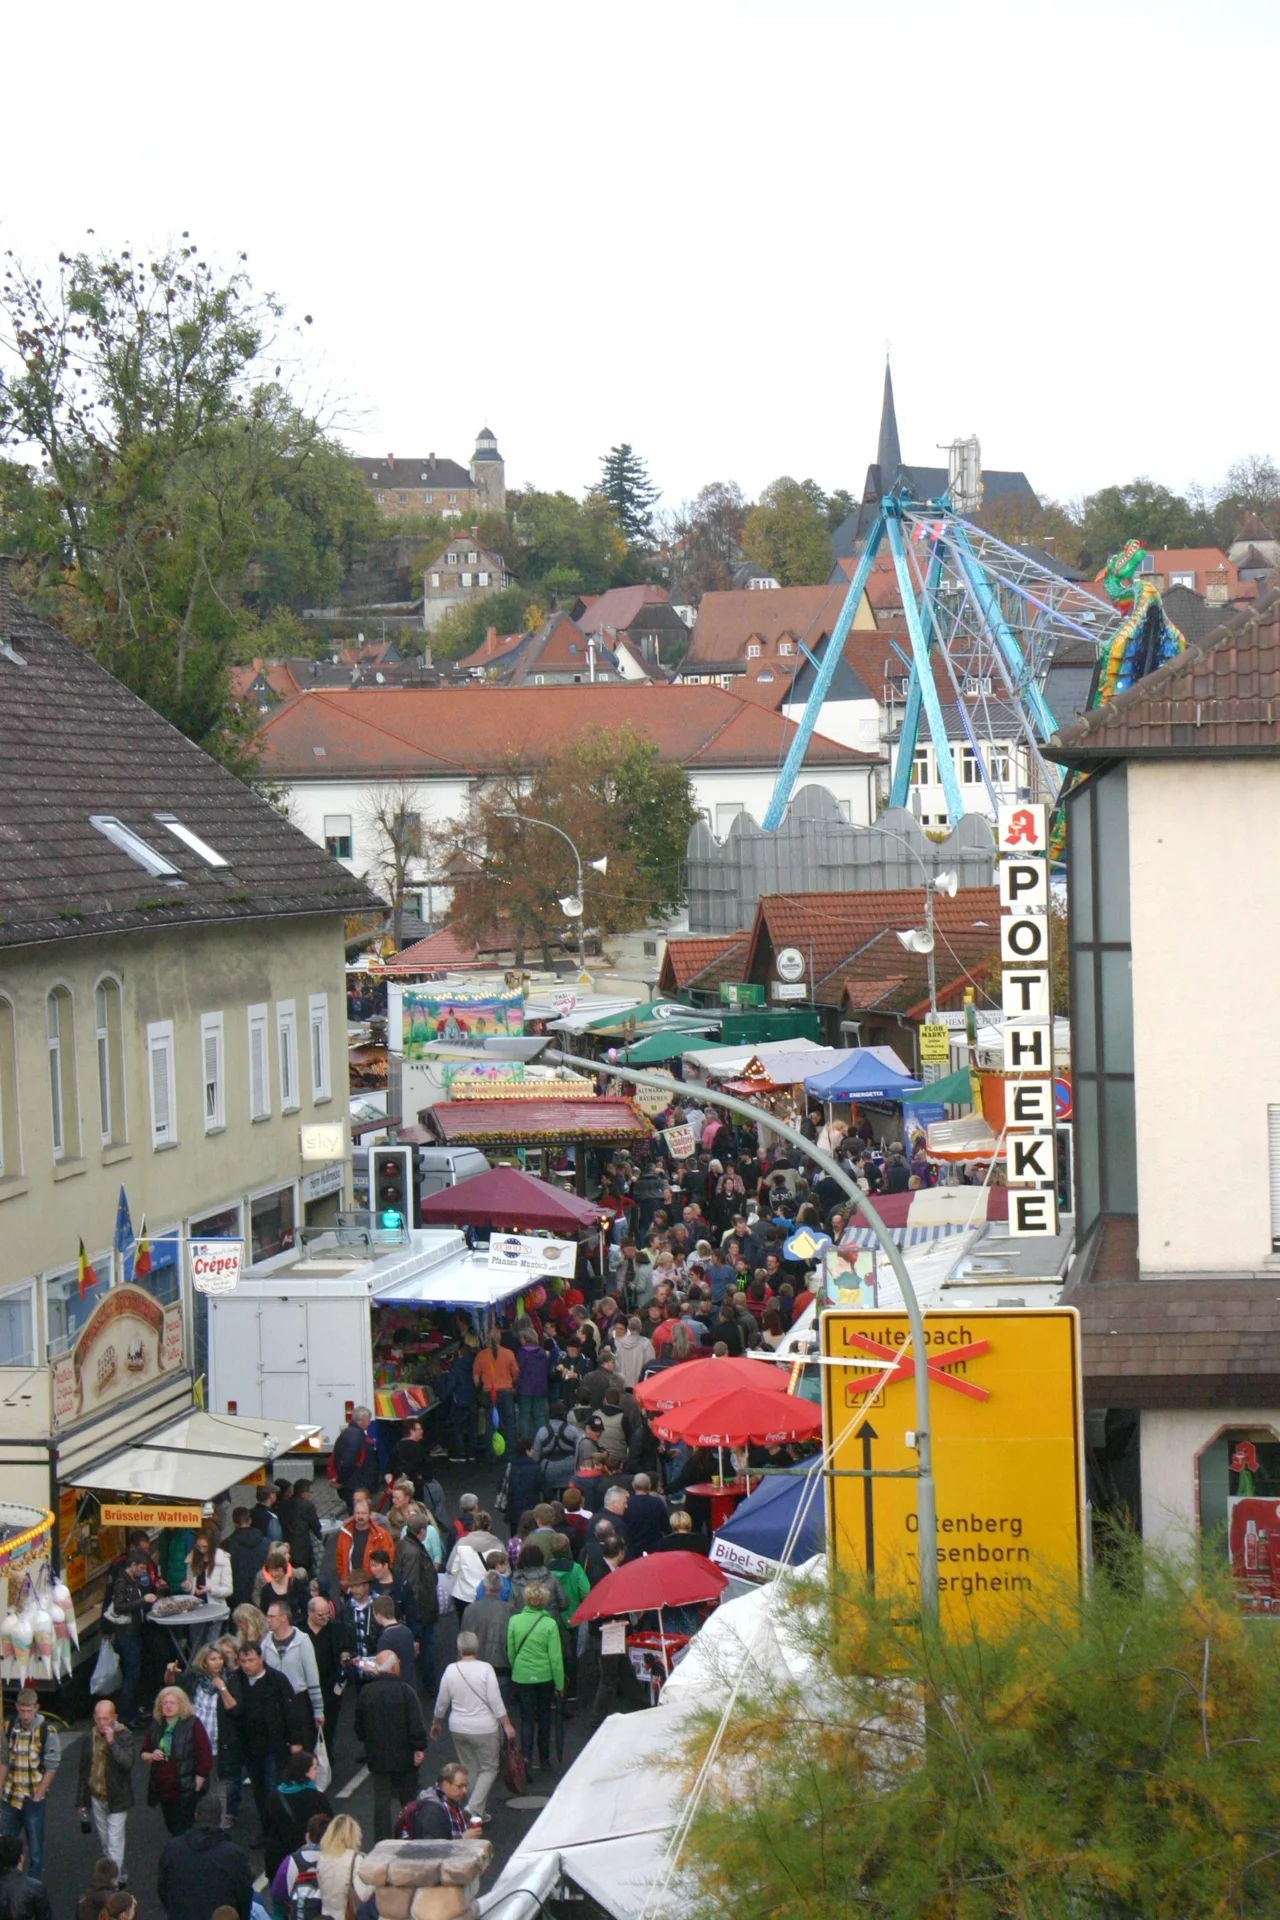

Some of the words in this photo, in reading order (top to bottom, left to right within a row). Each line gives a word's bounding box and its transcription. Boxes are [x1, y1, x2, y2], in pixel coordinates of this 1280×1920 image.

[945, 1018, 1001, 1026] HEMCHUH
[1004, 808, 1047, 1232] APOTHEKE
[849, 1090, 883, 1098] ENERGETIX
[306, 1132, 339, 1152] sky
[194, 1256, 238, 1275] Crêpes
[699, 1434, 721, 1443] Coca-Cola
[104, 1509, 154, 1521] Brüsseler
[157, 1511, 199, 1522] Waffeln
[905, 1513, 1022, 1538] Otenberg
[715, 1543, 754, 1567] Bibel-
[938, 1572, 1032, 1596] ergheim
